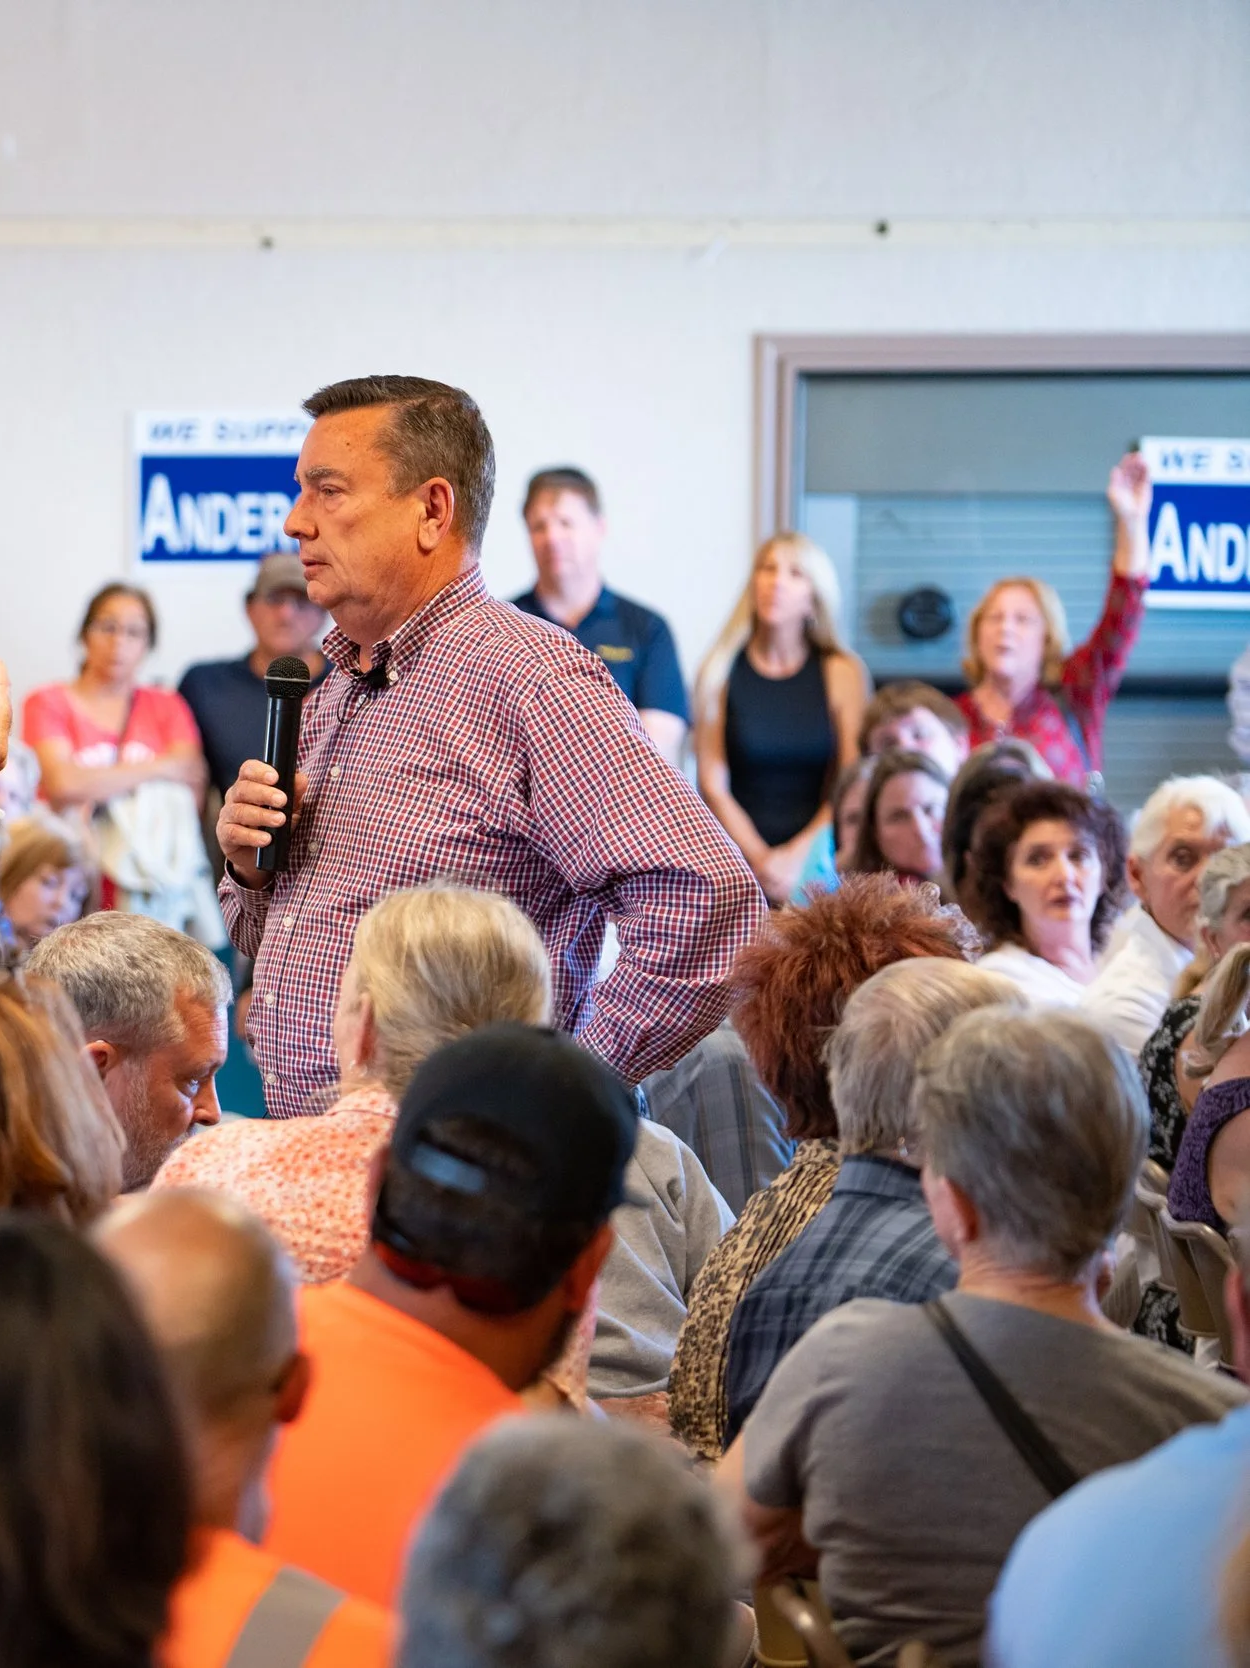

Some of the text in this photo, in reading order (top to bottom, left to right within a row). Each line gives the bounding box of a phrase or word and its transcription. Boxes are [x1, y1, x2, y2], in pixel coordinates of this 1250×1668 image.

[214, 417, 308, 442] SUPP
[143, 471, 301, 554] ANDER
[1151, 501, 1250, 583] AND
